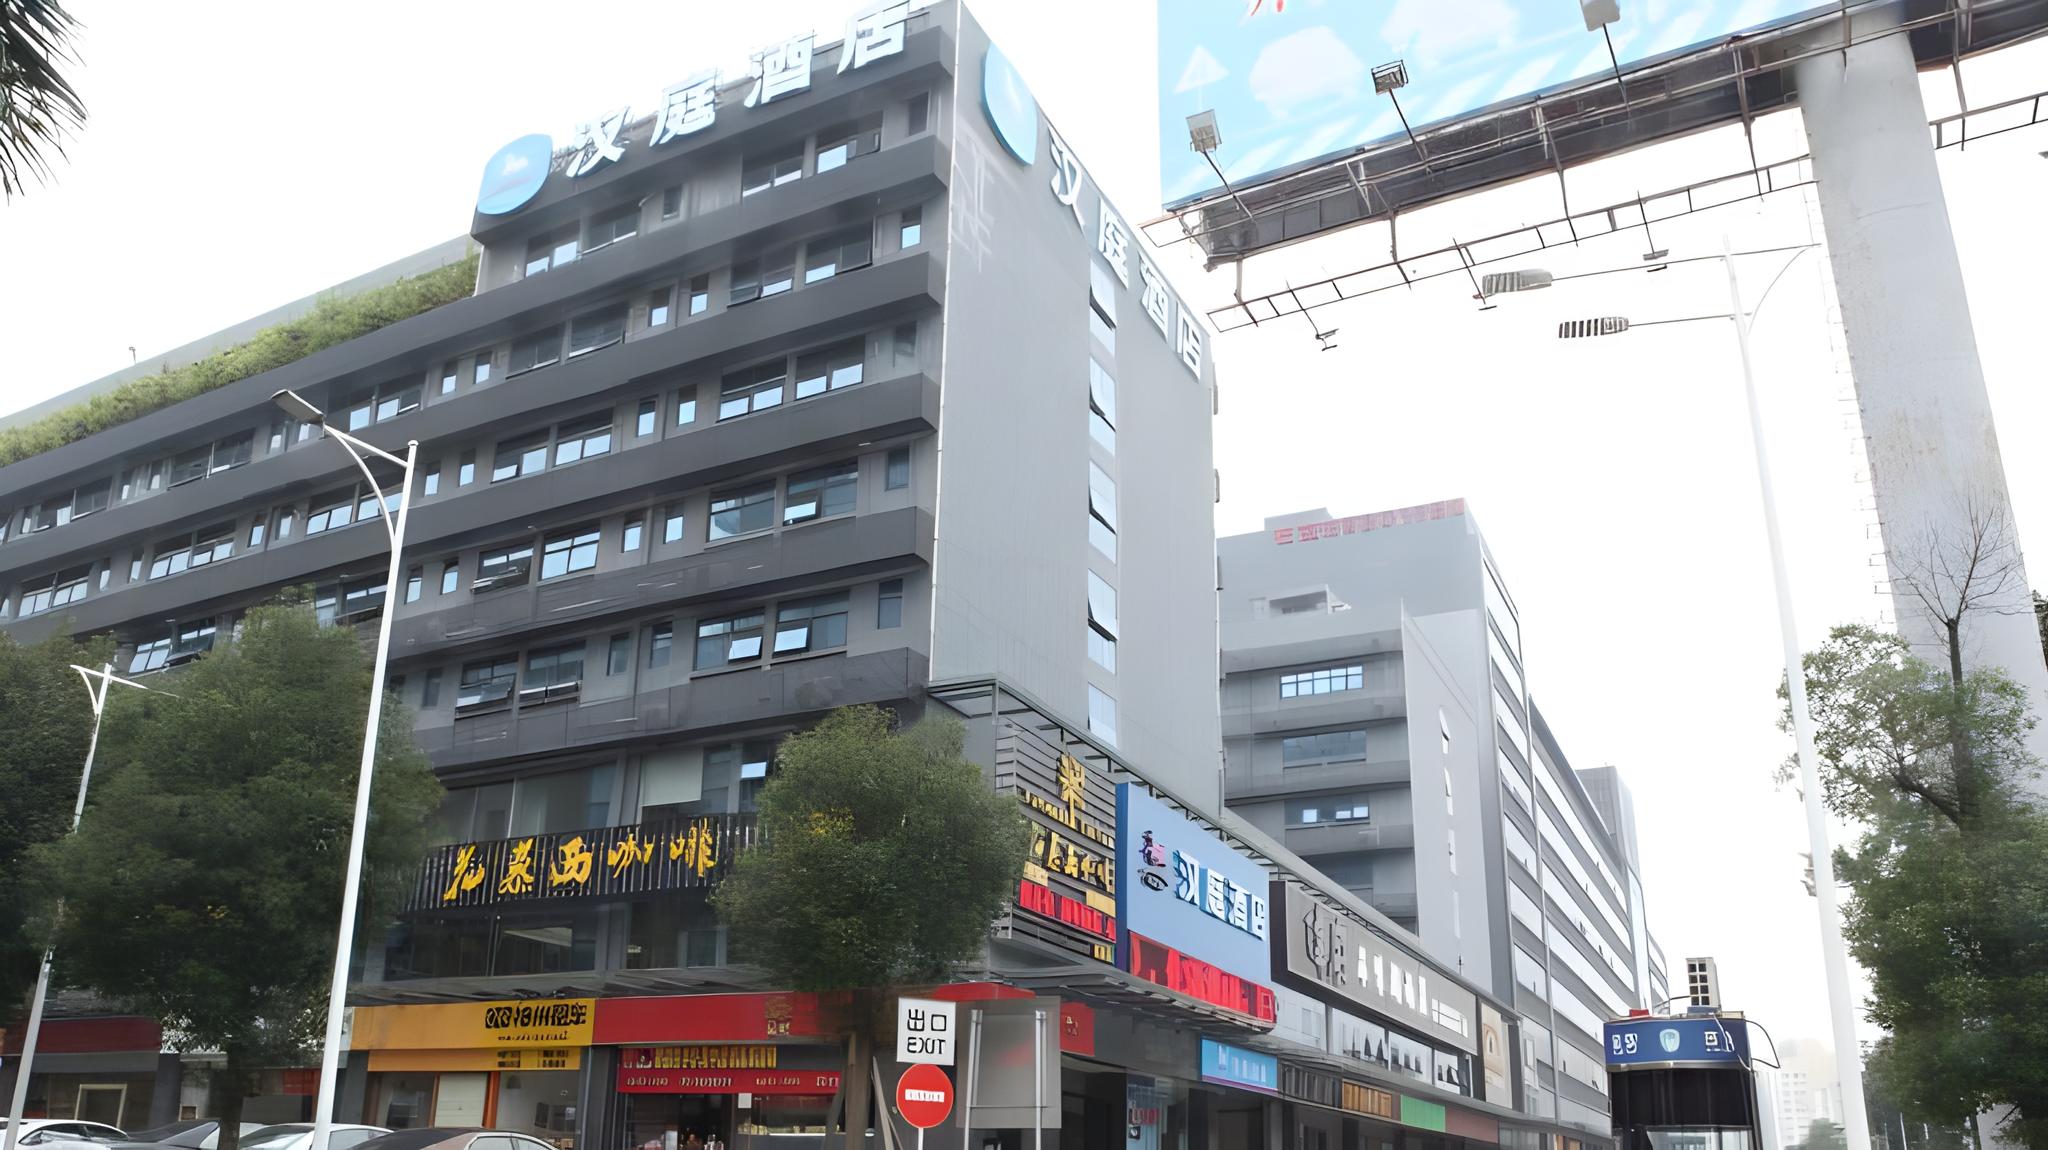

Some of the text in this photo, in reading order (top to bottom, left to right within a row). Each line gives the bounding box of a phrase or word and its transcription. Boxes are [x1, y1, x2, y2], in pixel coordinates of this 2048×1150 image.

[564, 1, 908, 178] 汉庭酒店
[1047, 126, 1202, 382] 汉庭酒店
[906, 1008, 947, 1032] 出口
[906, 1036, 946, 1055] EXIT
